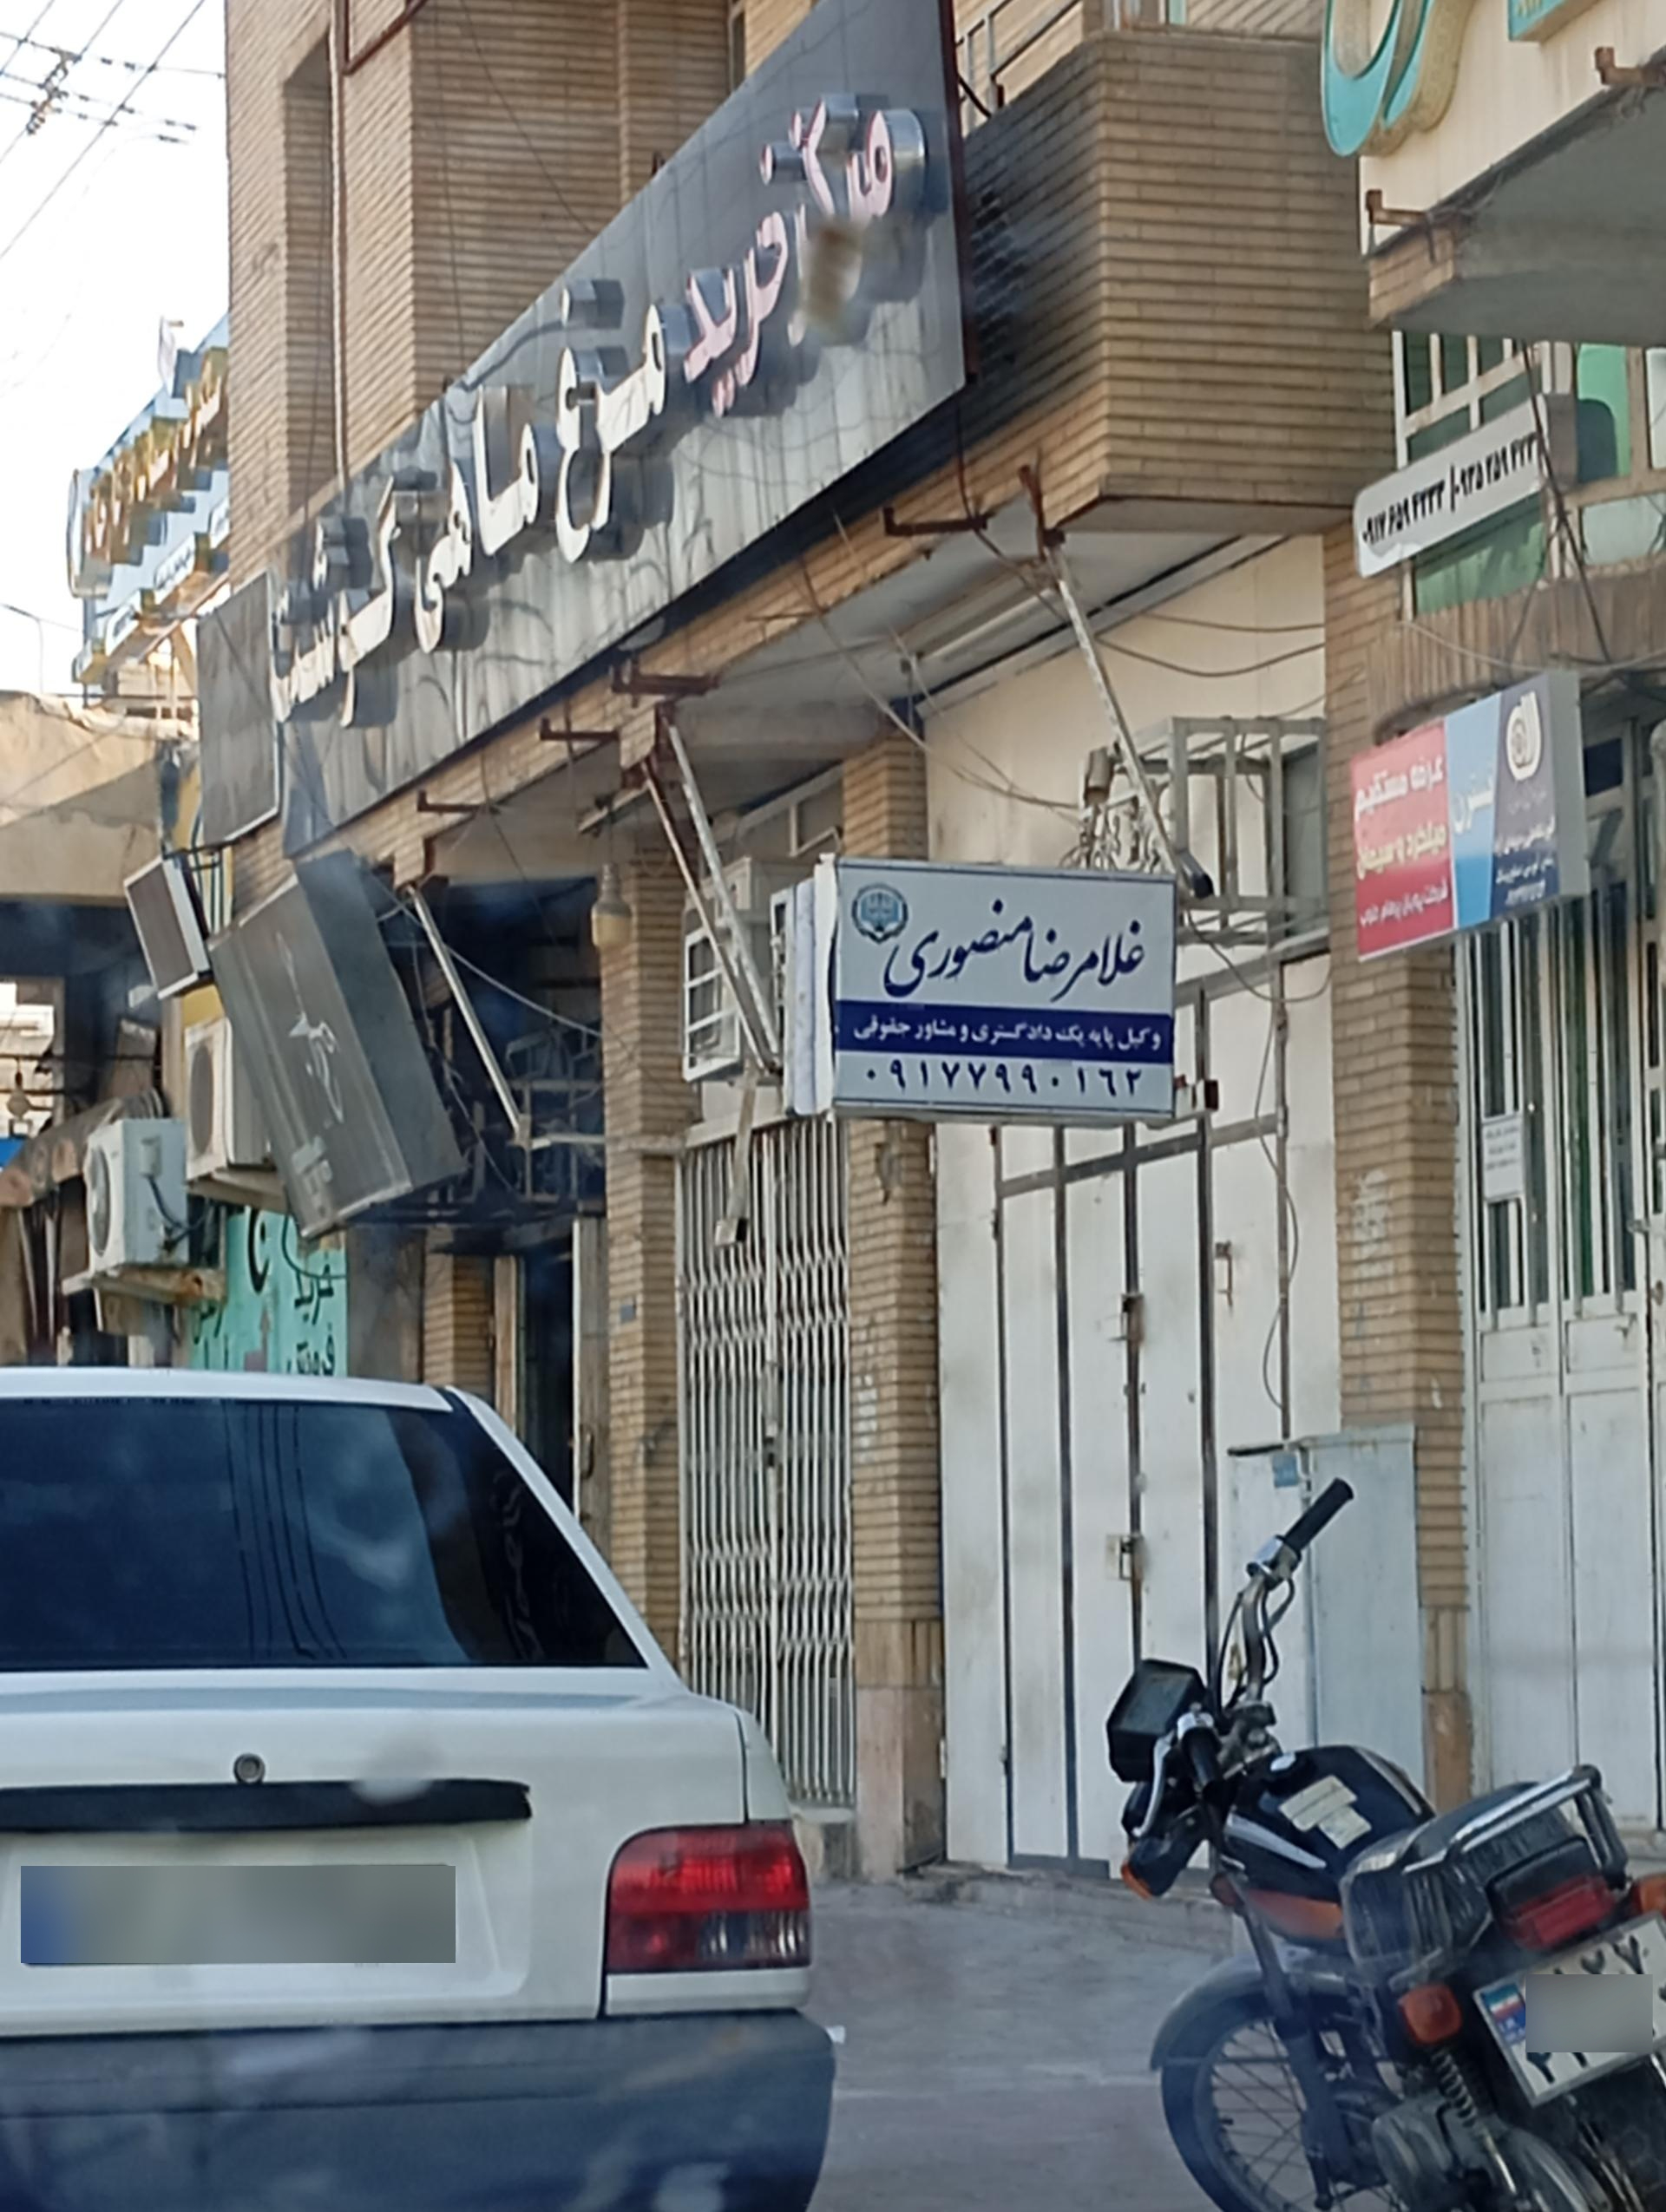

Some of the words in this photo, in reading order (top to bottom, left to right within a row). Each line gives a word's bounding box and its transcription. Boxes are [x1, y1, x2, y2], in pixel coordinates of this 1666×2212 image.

[684, 143, 788, 418] خرید
[555, 287, 666, 562] مرغ
[415, 383, 539, 654] ماهی
[269, 474, 400, 728] گوشت
[883, 899, 1034, 998] منصوری
[1024, 919, 1146, 1003] غلامرضا
[853, 1013, 911, 1042] حقوقی
[914, 1018, 957, 1042] مشاور
[959, 1024, 969, 1044] و
[970, 1021, 1053, 1046] دادگستری
[1054, 1024, 1086, 1049] یک
